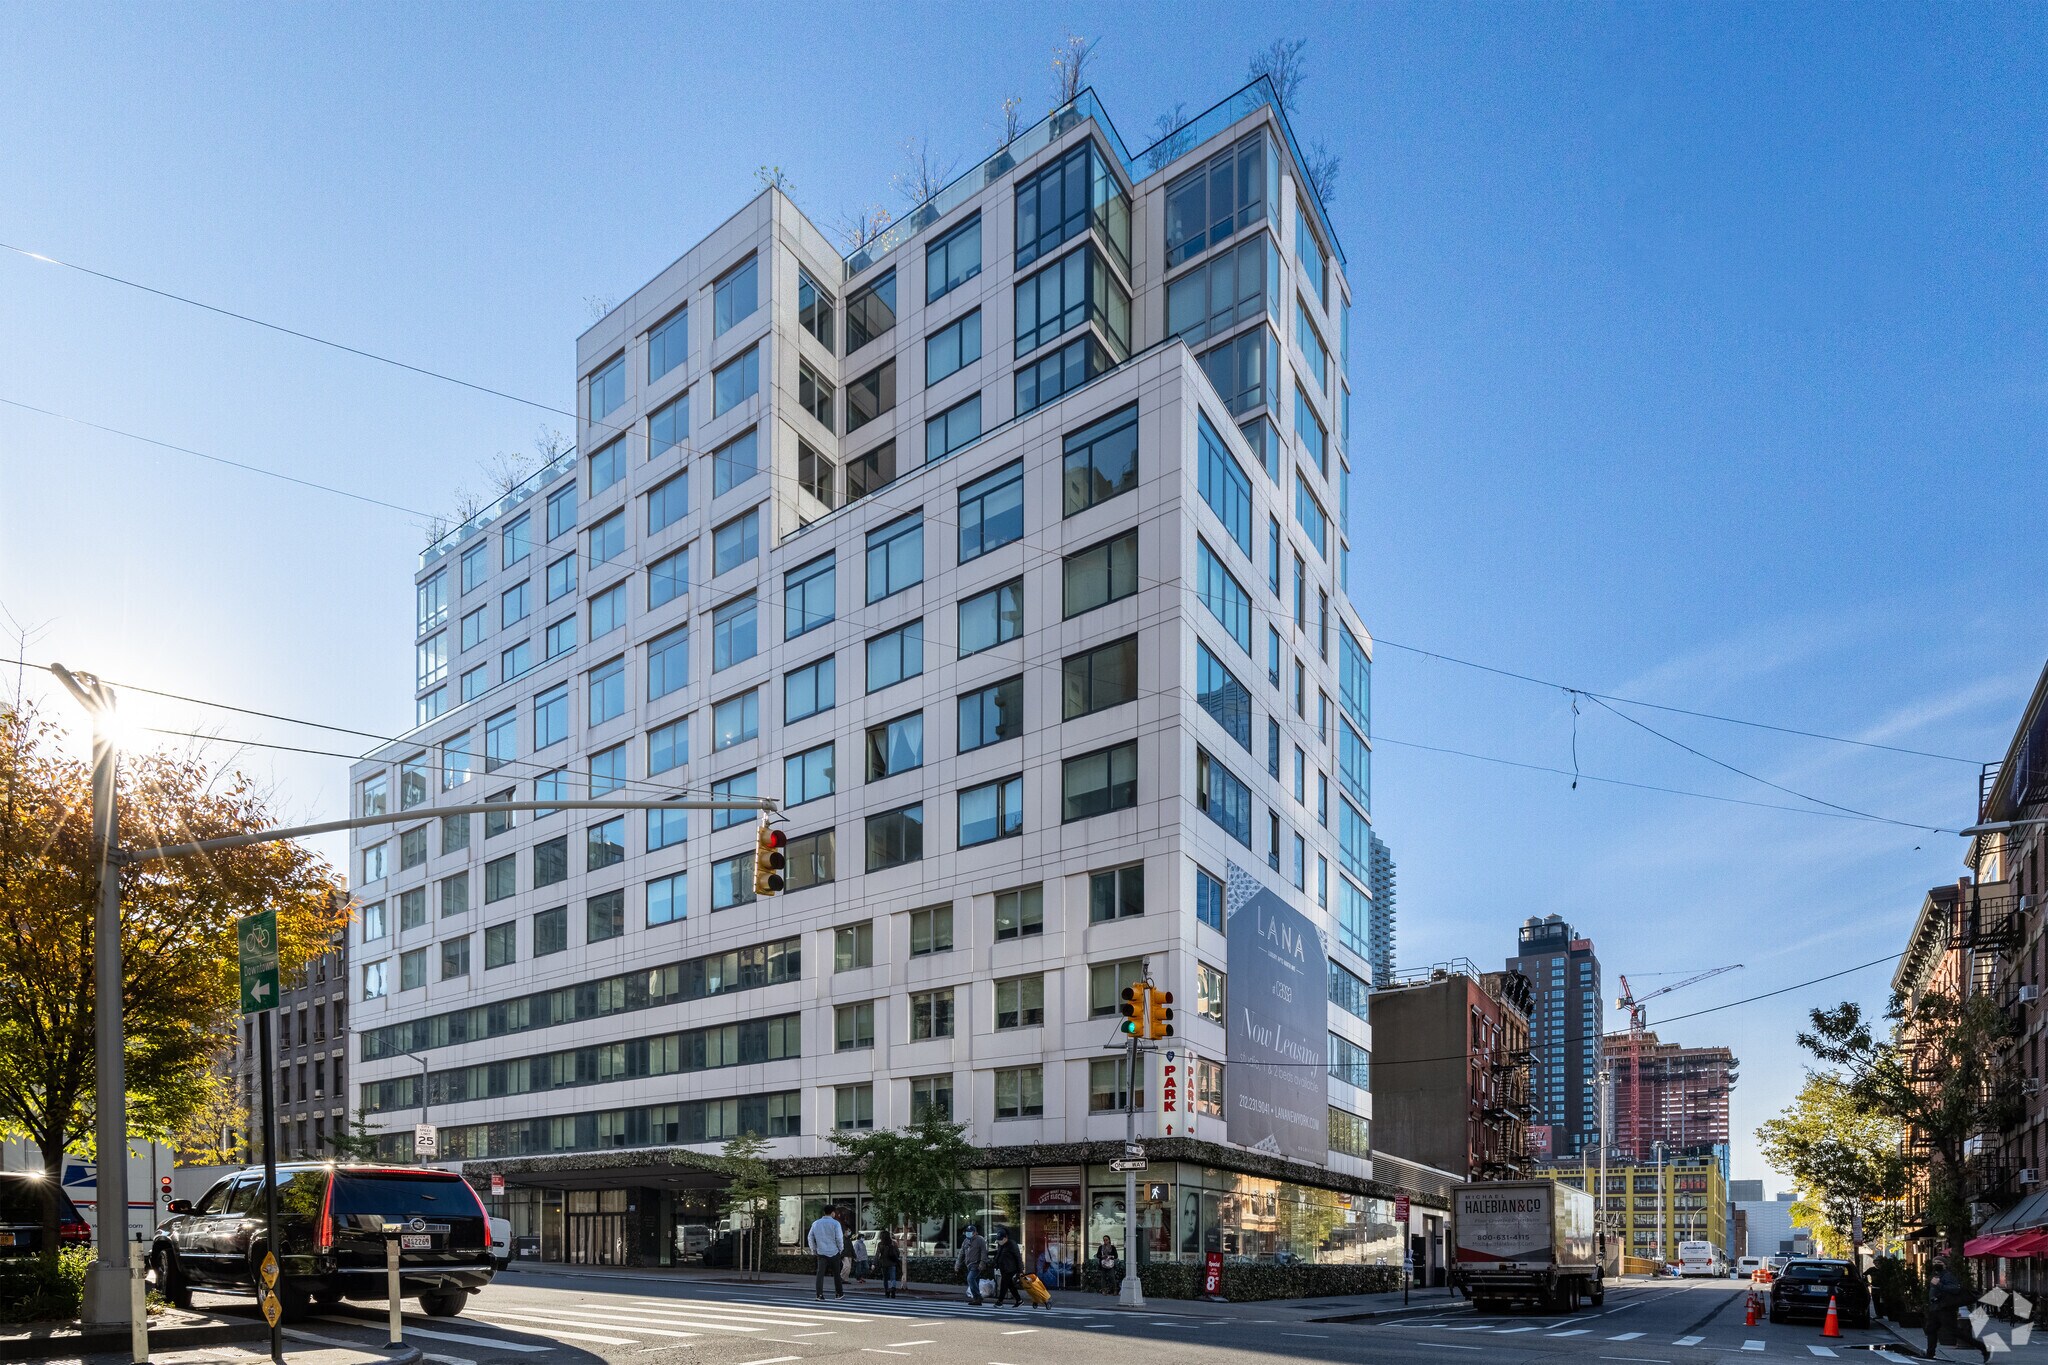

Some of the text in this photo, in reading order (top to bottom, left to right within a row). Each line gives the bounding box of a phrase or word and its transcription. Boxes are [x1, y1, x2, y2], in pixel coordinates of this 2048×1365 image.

[1257, 905, 1305, 963] LANA
[243, 960, 275, 977] Downtown
[1240, 1007, 1319, 1079] Now Leasing
[1164, 1065, 1177, 1113] PARK
[1187, 1065, 1195, 1114] PARK
[418, 1136, 434, 1145] 25
[1050, 1193, 1072, 1204] ELECTION
